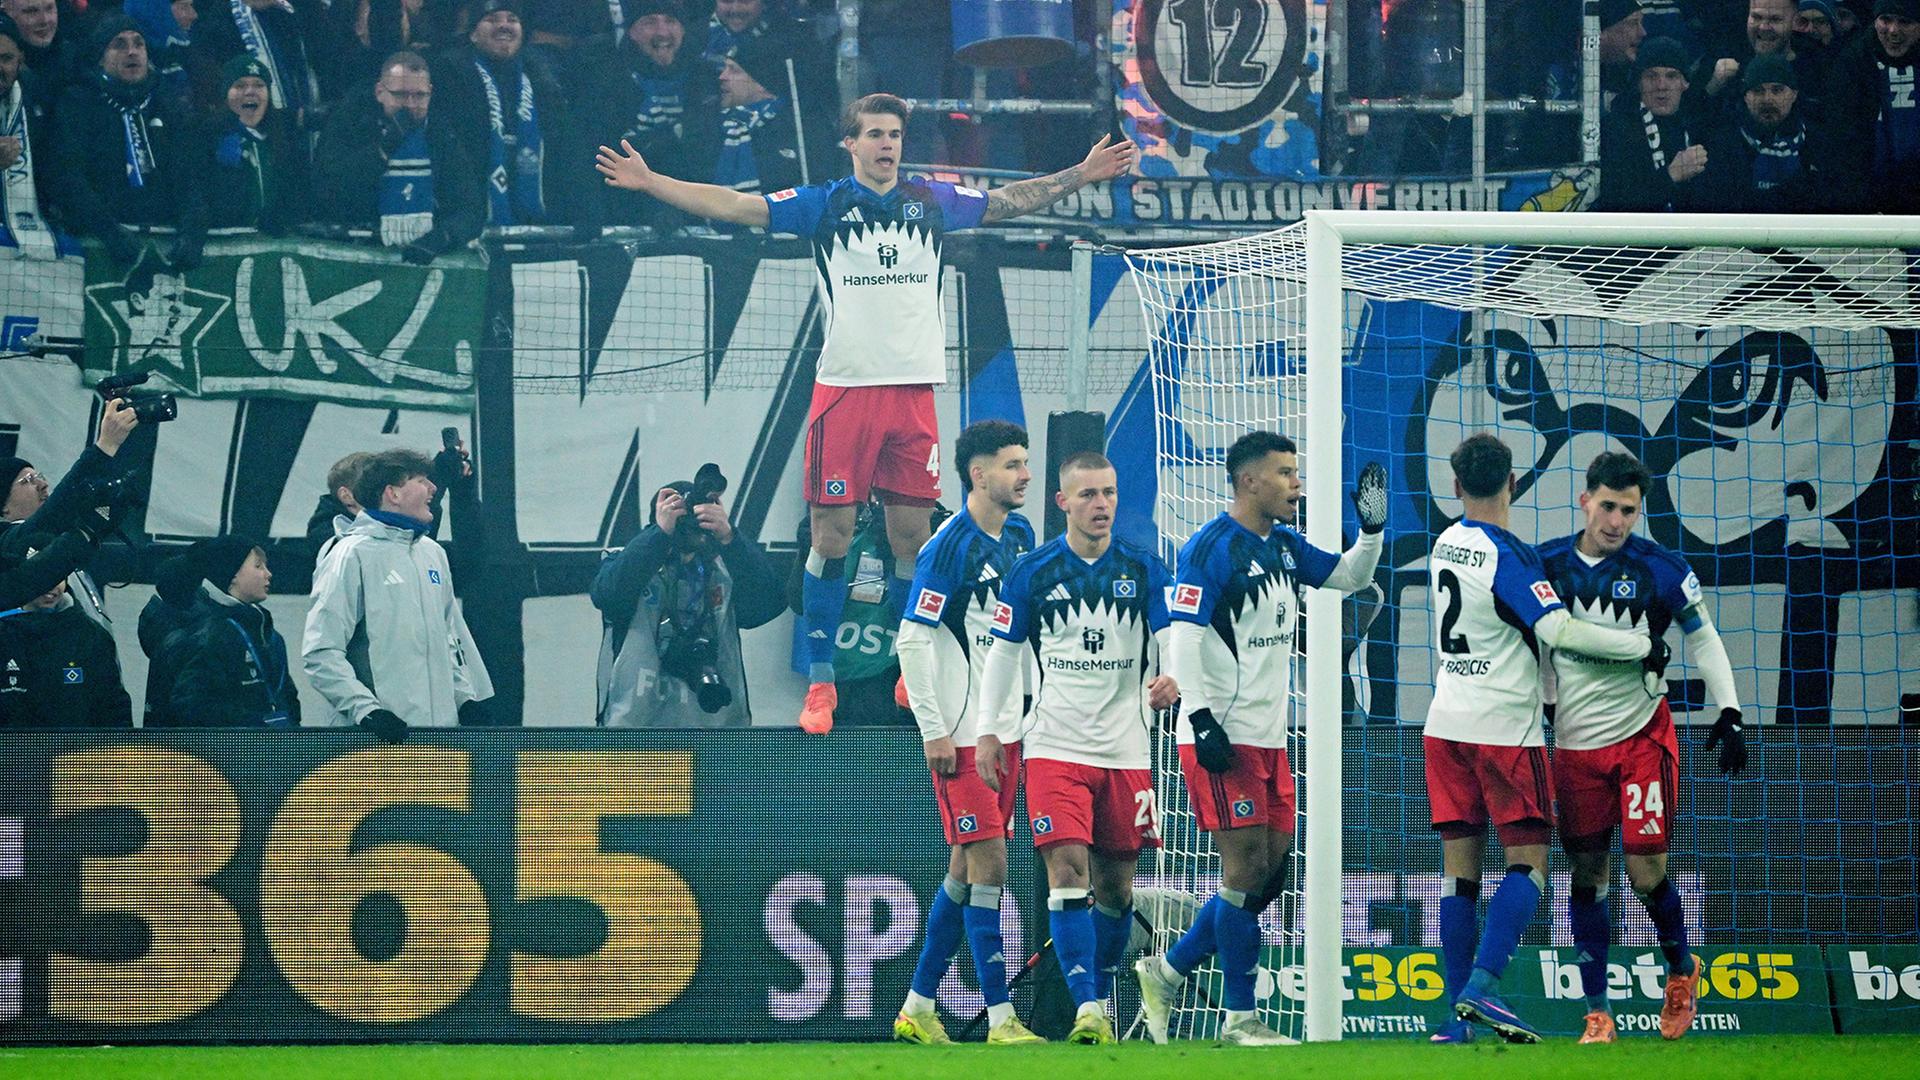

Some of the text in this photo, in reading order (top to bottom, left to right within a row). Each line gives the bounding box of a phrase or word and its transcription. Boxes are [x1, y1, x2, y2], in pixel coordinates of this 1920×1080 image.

[1167, 0, 1268, 88] 12
[1132, 179, 1507, 222] STADIONVERBOT
[843, 272, 929, 286] HanseMerkur
[1471, 550, 1487, 568] SV
[1438, 568, 1471, 655] 2
[1047, 656, 1135, 671] HanseMerkur
[1626, 781, 1664, 819] 24
[1616, 1013, 1741, 1031] SPORETTEN
